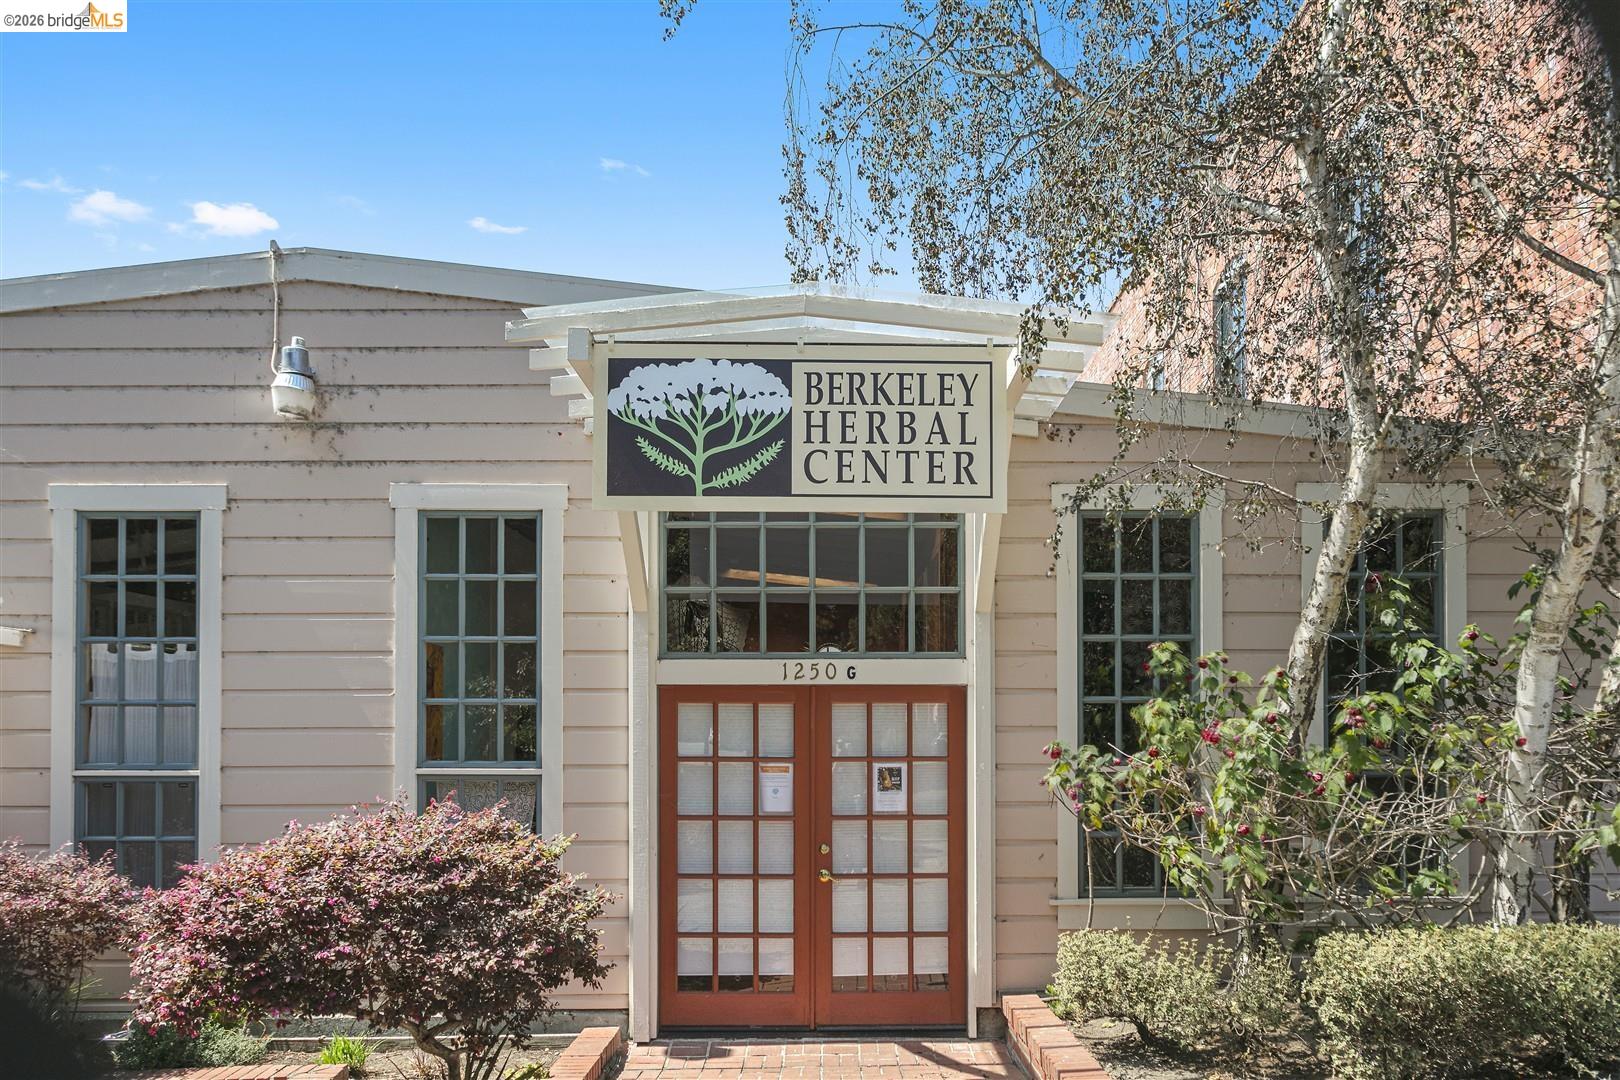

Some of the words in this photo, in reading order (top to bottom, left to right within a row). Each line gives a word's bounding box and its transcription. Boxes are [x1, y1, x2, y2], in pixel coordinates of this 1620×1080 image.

[803, 371, 979, 407] BERKELEY
[803, 410, 978, 446] HERBAL
[803, 449, 978, 485] CENTER
[782, 662, 837, 681] 1250
[846, 665, 857, 680] G
